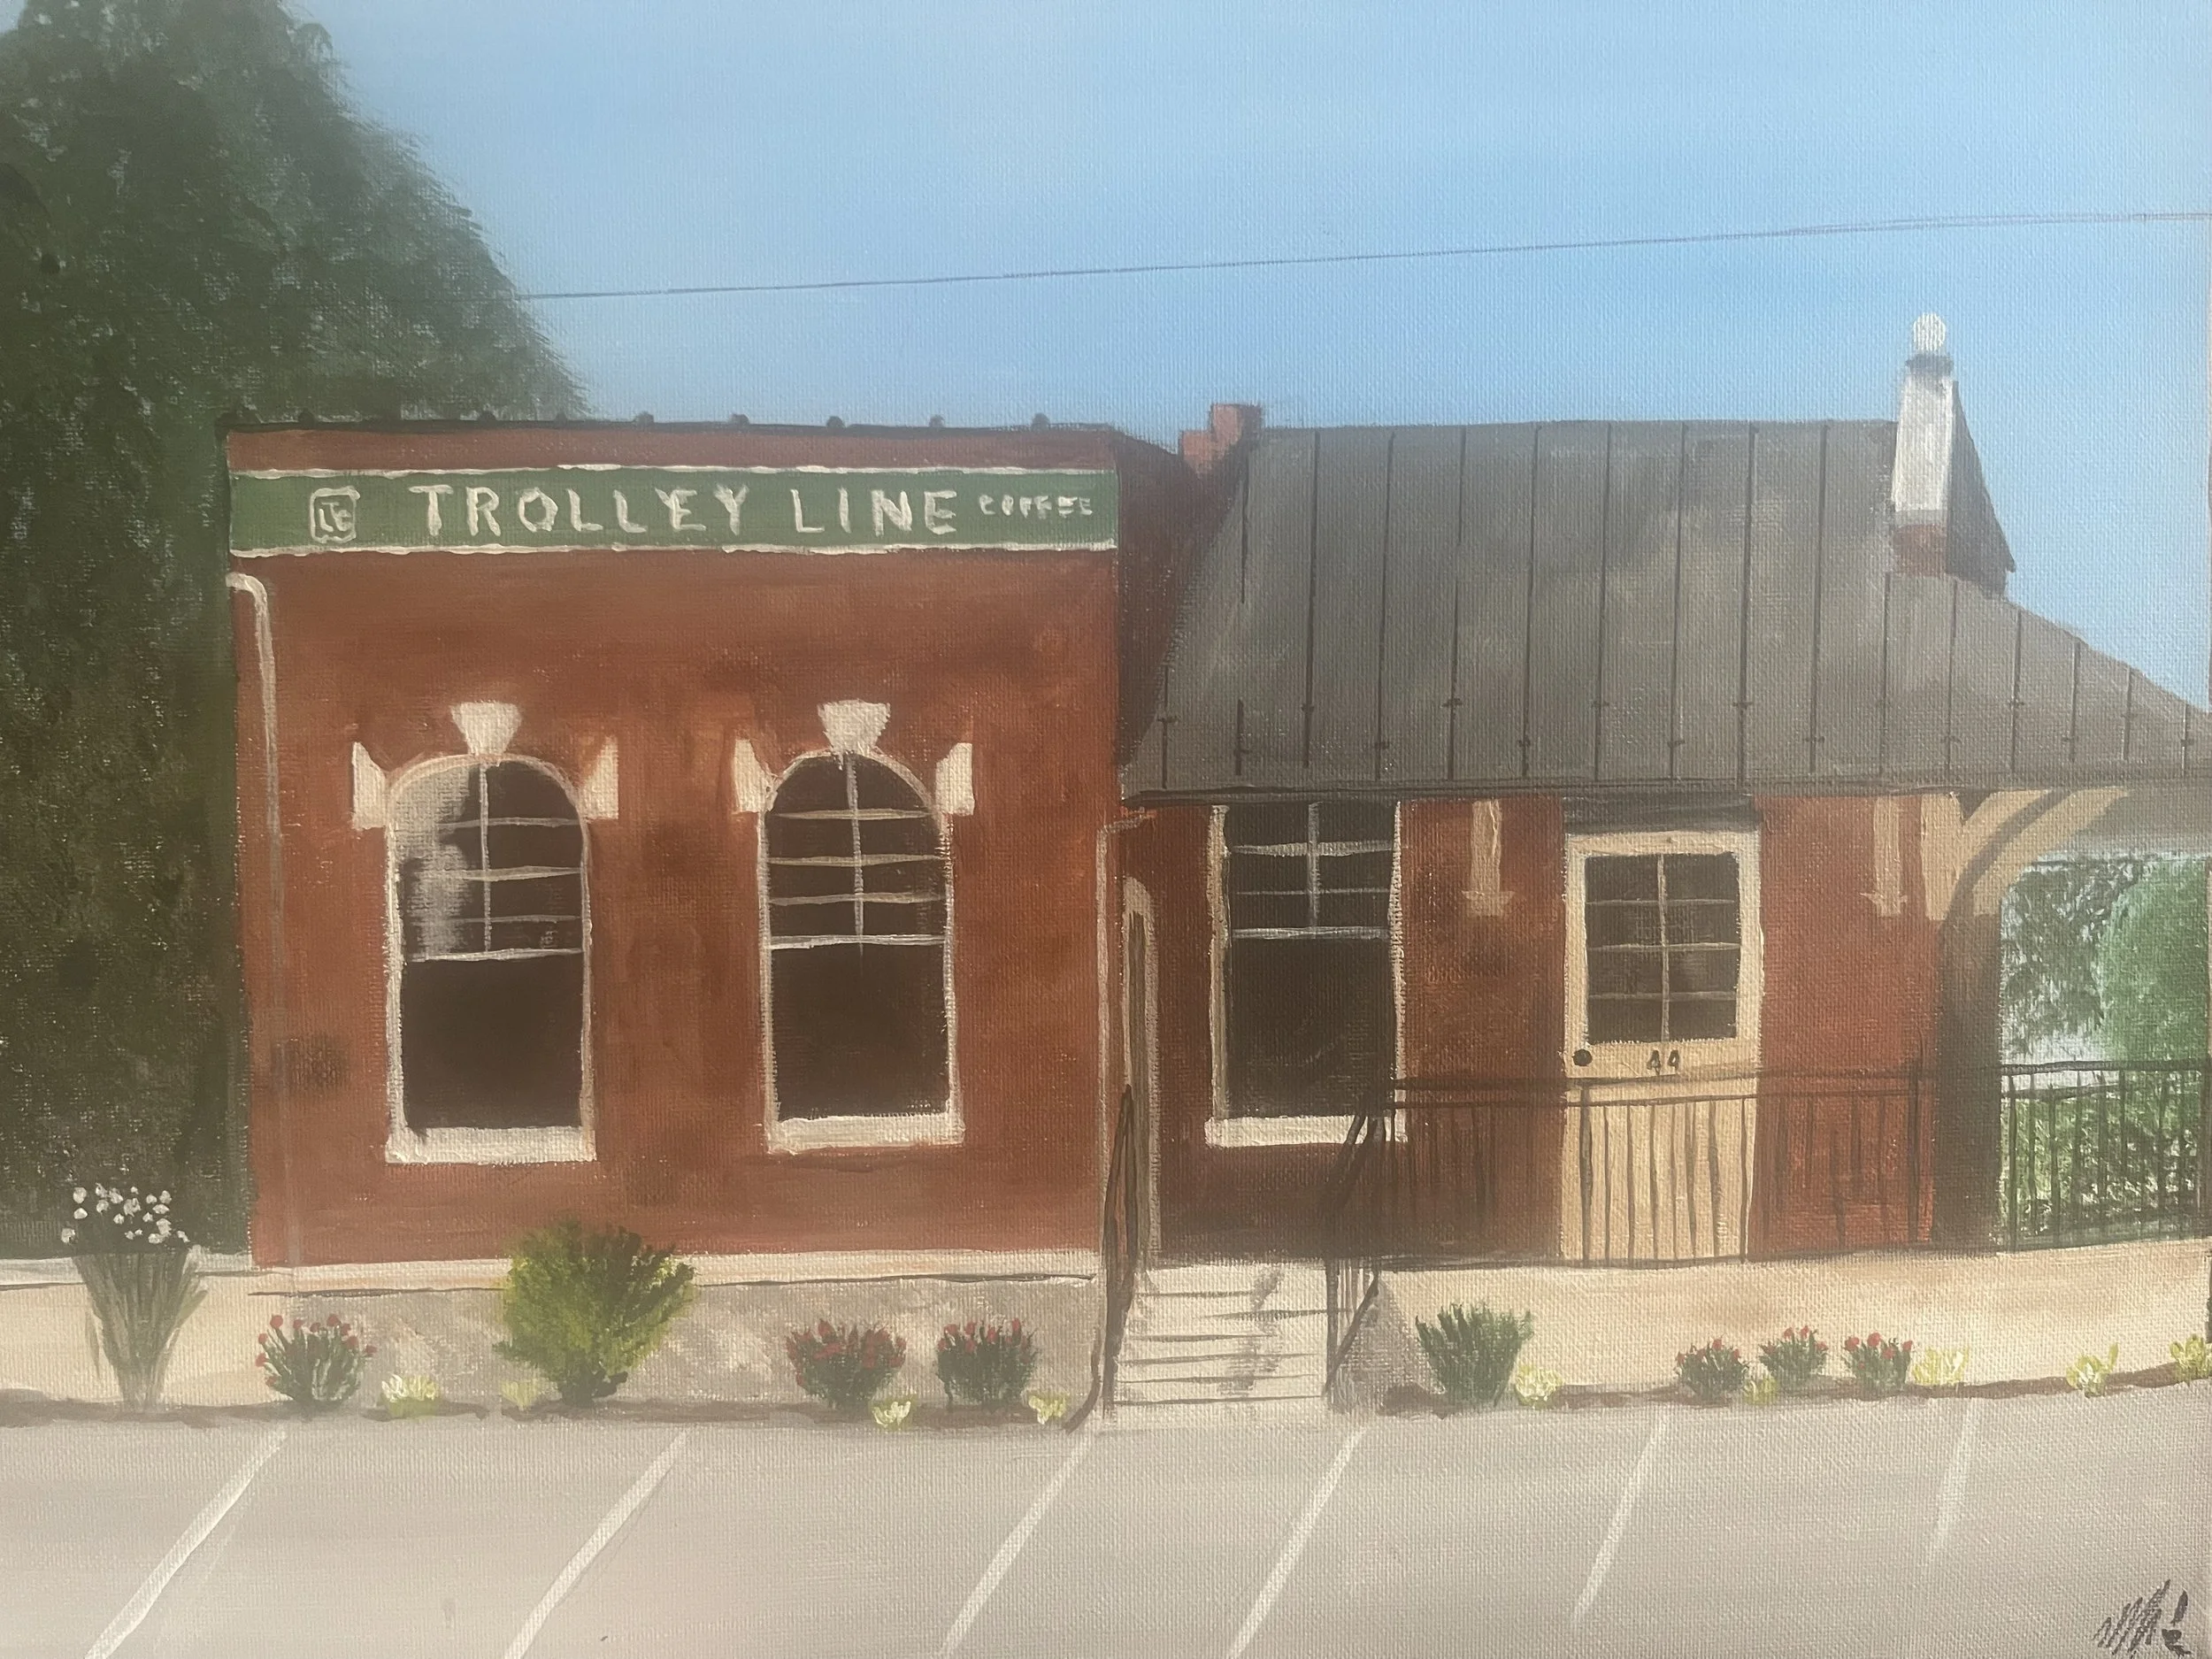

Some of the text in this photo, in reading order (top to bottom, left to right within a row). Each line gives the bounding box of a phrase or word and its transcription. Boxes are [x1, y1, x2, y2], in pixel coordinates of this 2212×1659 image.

[410, 484, 1094, 536] TROLLEY LINE COFFEE
